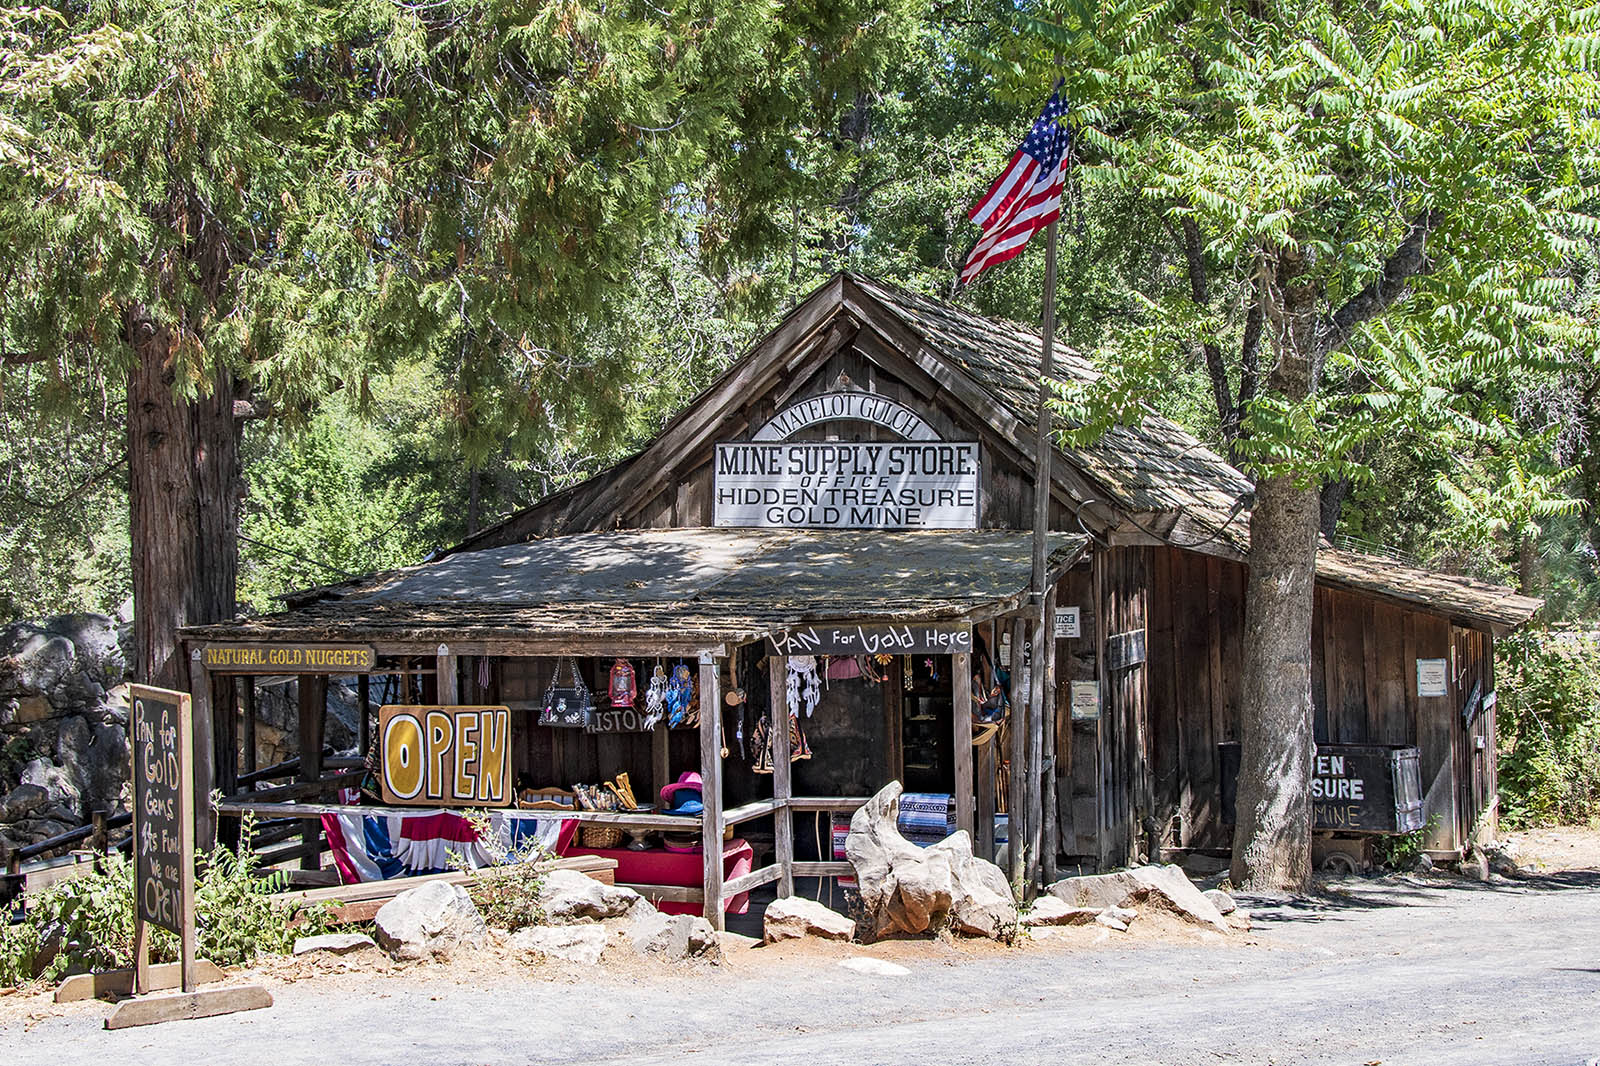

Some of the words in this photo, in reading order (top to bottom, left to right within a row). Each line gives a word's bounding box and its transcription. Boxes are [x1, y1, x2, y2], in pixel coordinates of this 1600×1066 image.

[770, 395, 857, 439] MATELOT
[718, 447, 783, 475] MINE
[788, 447, 885, 475] SUPPLY
[800, 476, 890, 488] OFFICE
[718, 489, 818, 505] HIDDEN
[824, 489, 974, 507] TREASURE
[766, 507, 840, 525] GOLD
[769, 626, 821, 655] PAN
[832, 631, 856, 644] For
[858, 625, 915, 653] Gold
[926, 629, 969, 647] Here
[207, 649, 266, 665] NATURAL
[269, 649, 302, 665] GOLD
[305, 649, 369, 666] NUGGETS
[383, 711, 507, 801] OPEN
